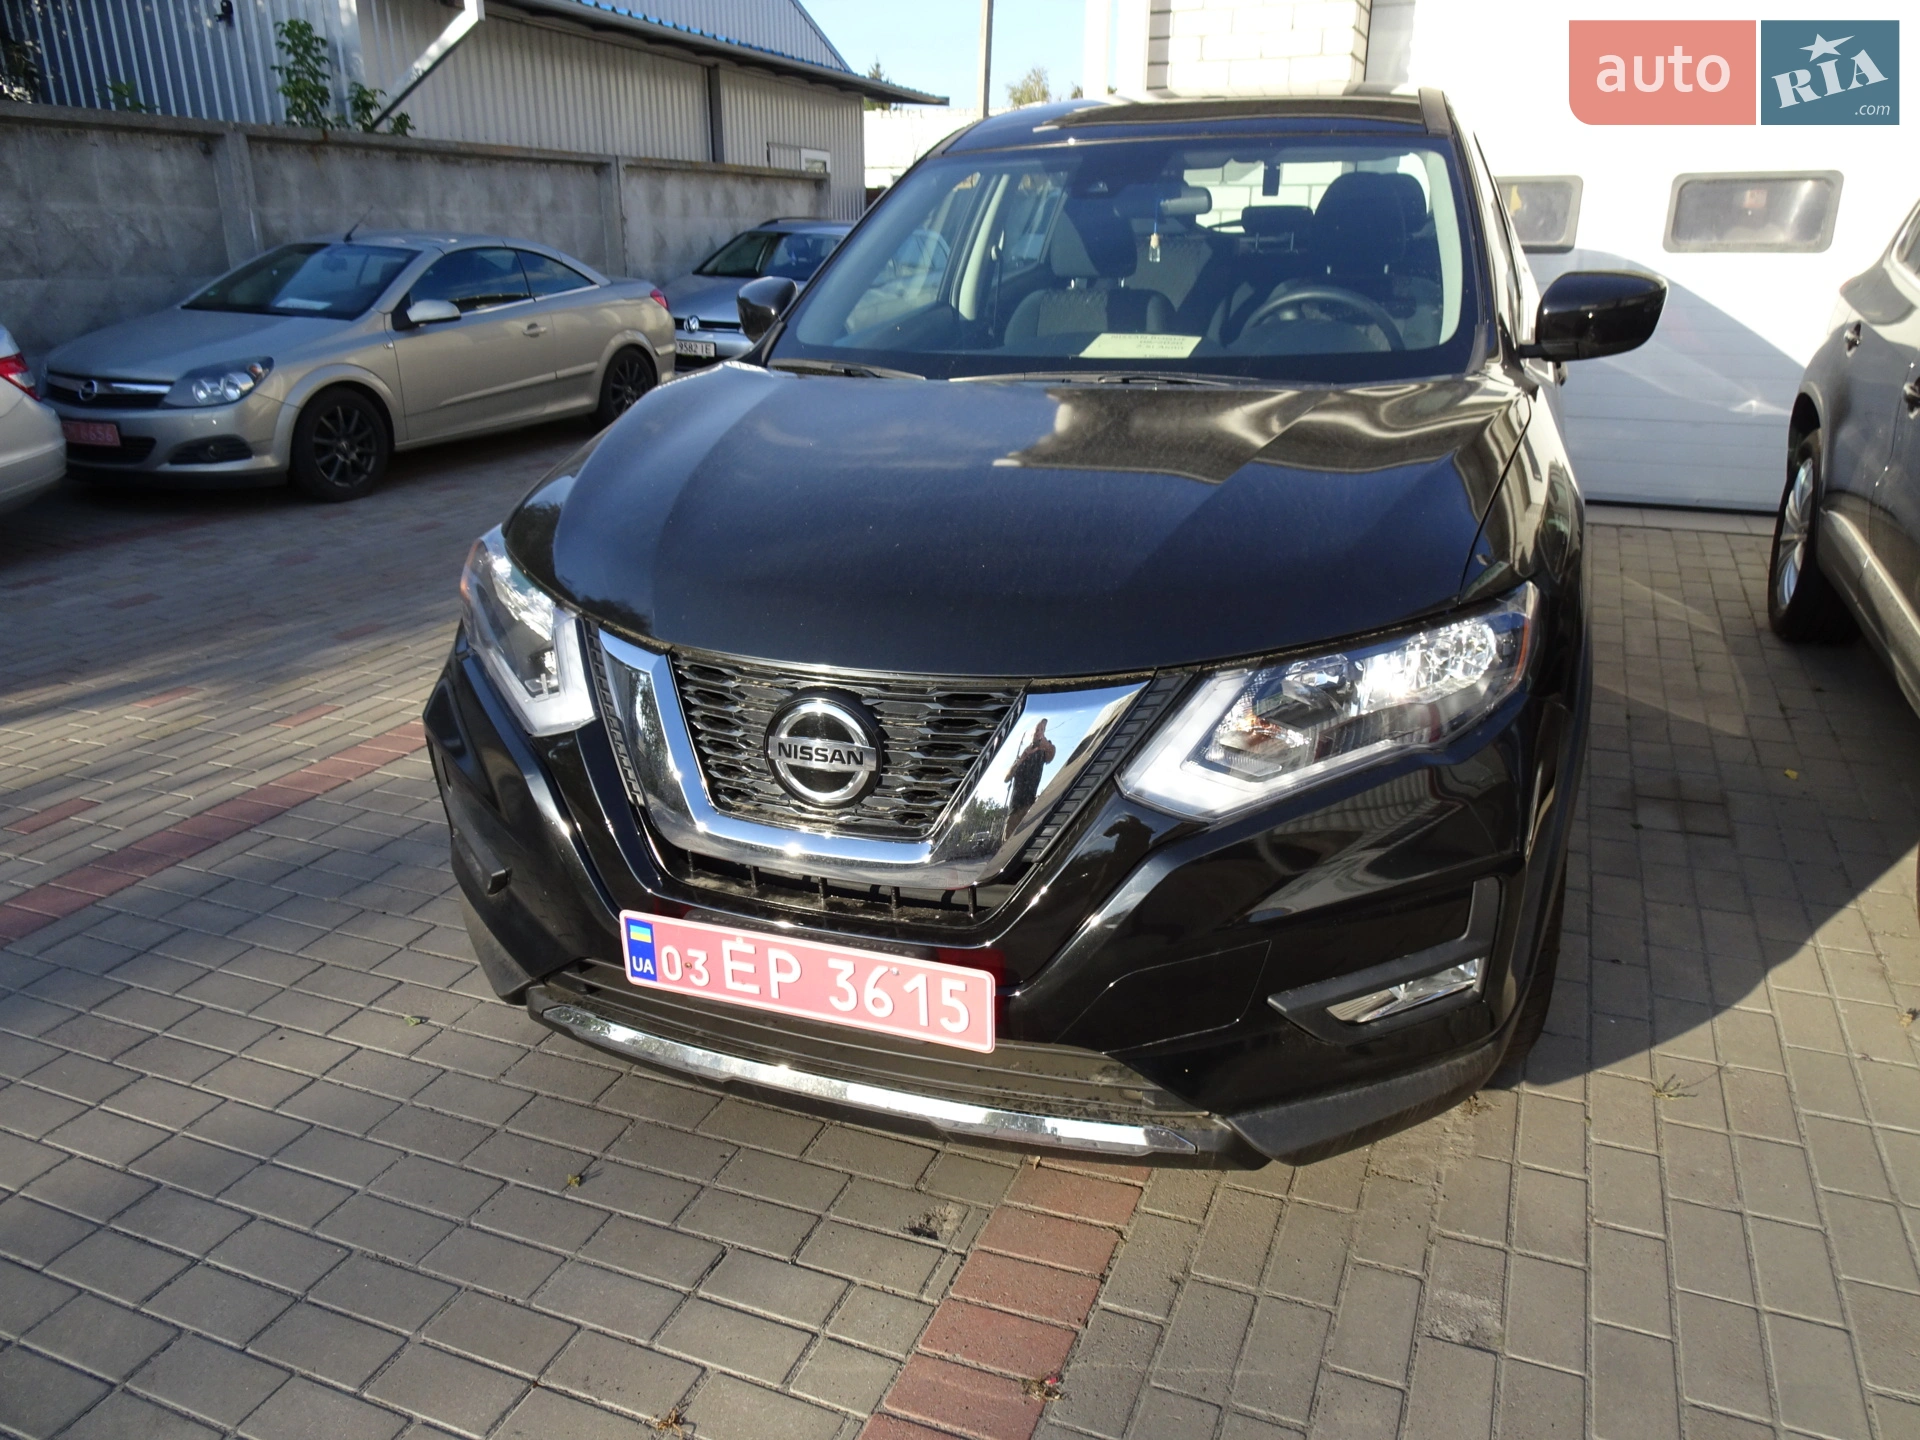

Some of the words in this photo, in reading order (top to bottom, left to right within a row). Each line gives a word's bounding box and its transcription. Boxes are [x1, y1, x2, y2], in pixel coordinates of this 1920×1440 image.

[678, 342, 698, 353] 9582
[777, 742, 864, 766] NISSAN
[631, 955, 655, 975] UA
[661, 945, 711, 987] 03
[722, 939, 802, 999] EP
[827, 957, 971, 1034] 3615
